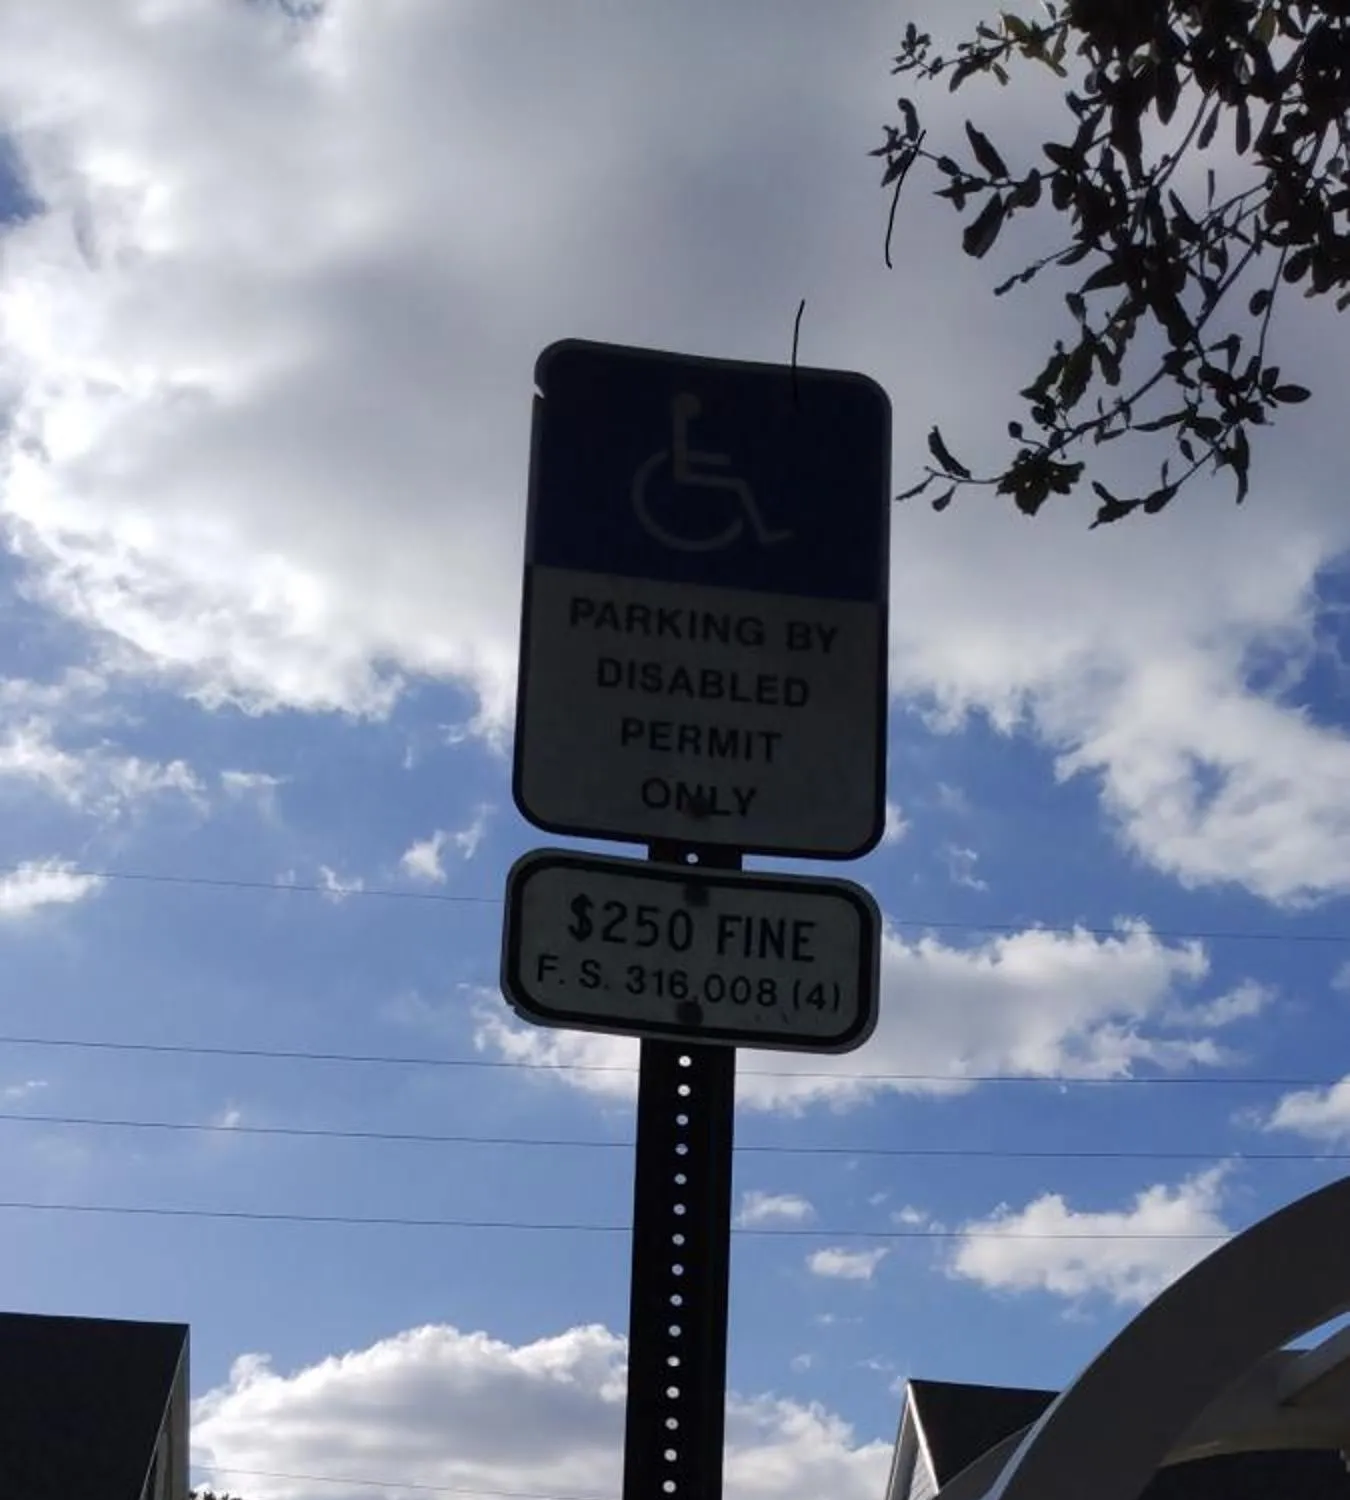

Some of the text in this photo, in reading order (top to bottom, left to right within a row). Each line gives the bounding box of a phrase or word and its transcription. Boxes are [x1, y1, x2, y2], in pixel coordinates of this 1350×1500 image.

[570, 598, 838, 653] PARKING BY
[598, 658, 809, 707] DISABLED
[621, 717, 782, 762] PERMIT
[641, 777, 756, 816] ONLY
[569, 893, 815, 962] $250 FINE
[793, 981, 840, 1011] (4)
